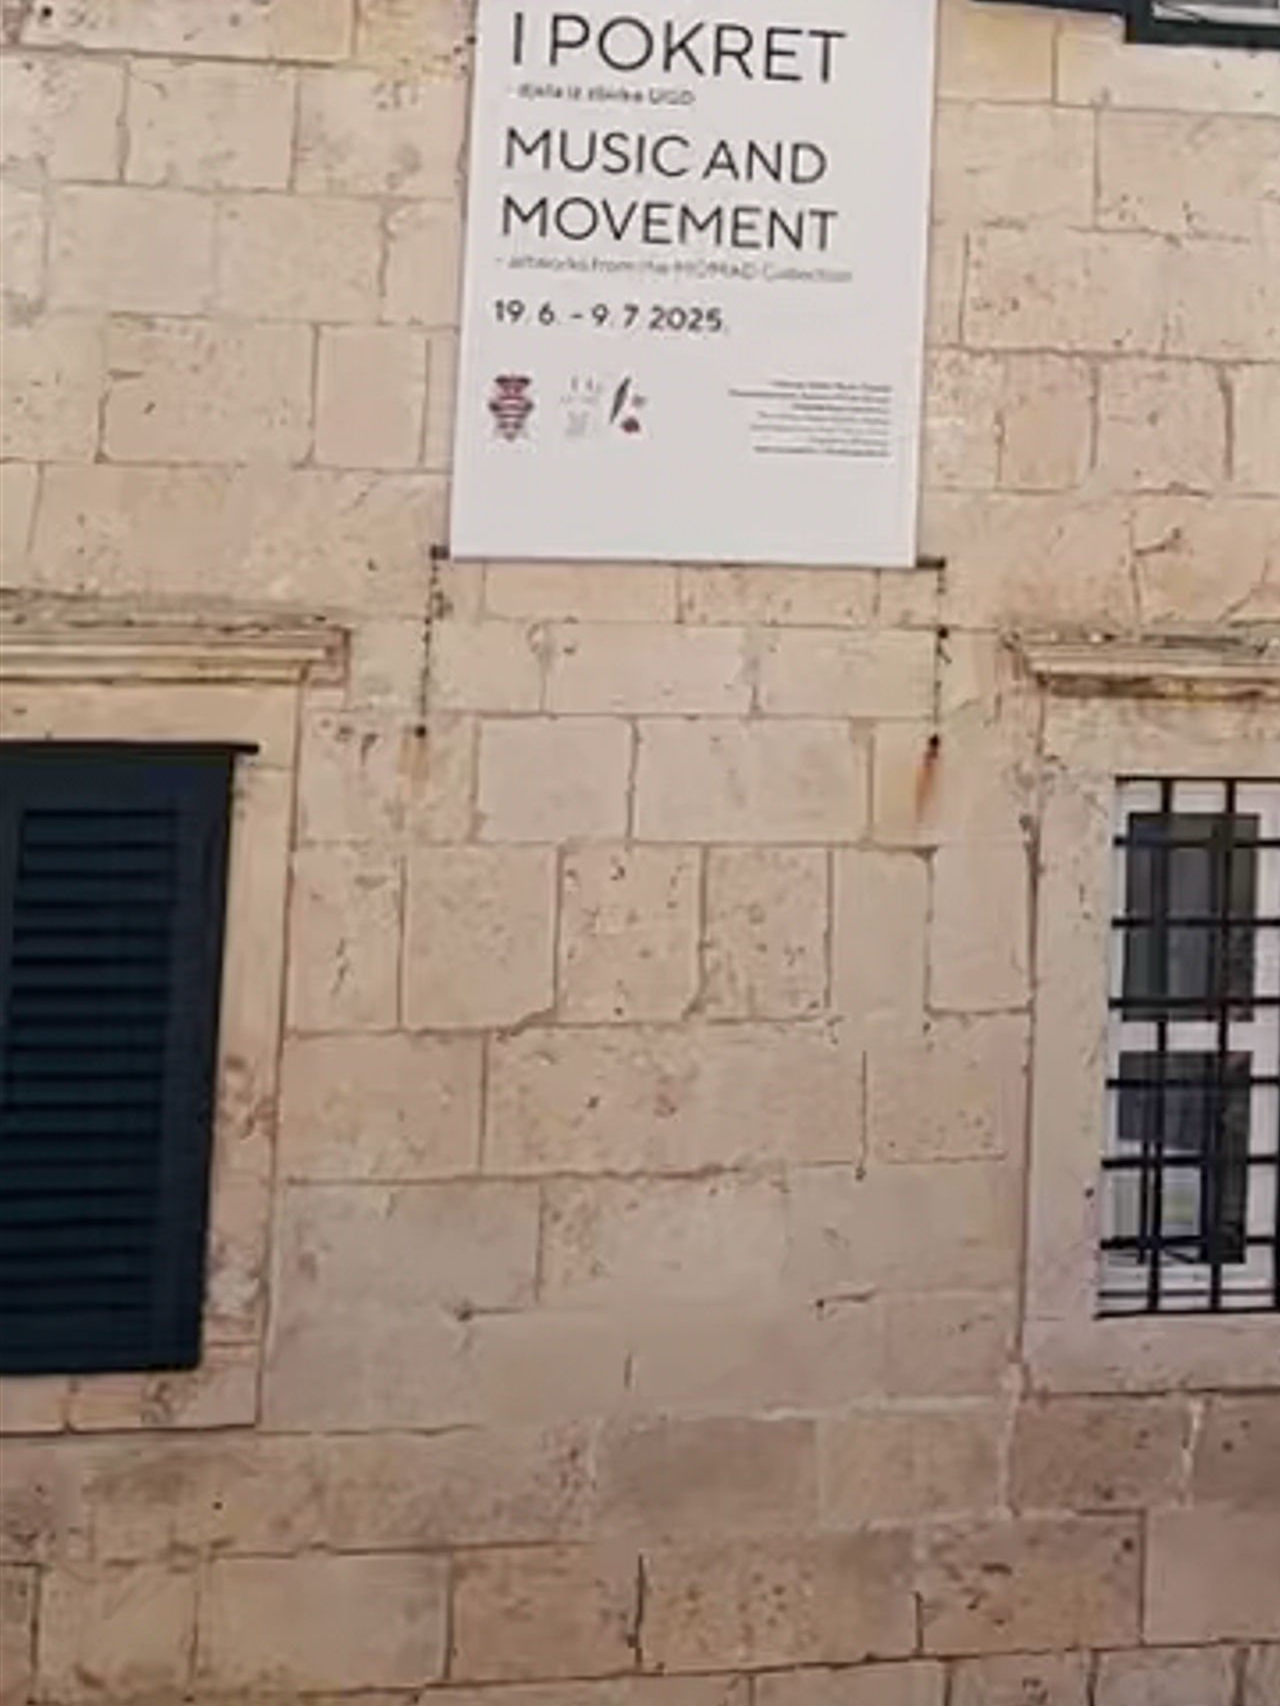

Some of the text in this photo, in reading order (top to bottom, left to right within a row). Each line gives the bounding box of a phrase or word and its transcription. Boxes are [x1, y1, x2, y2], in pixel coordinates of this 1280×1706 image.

[512, 12, 847, 83] I POKRET
[505, 127, 827, 185] MUSIC AND
[501, 195, 838, 251] MOVEMENT
